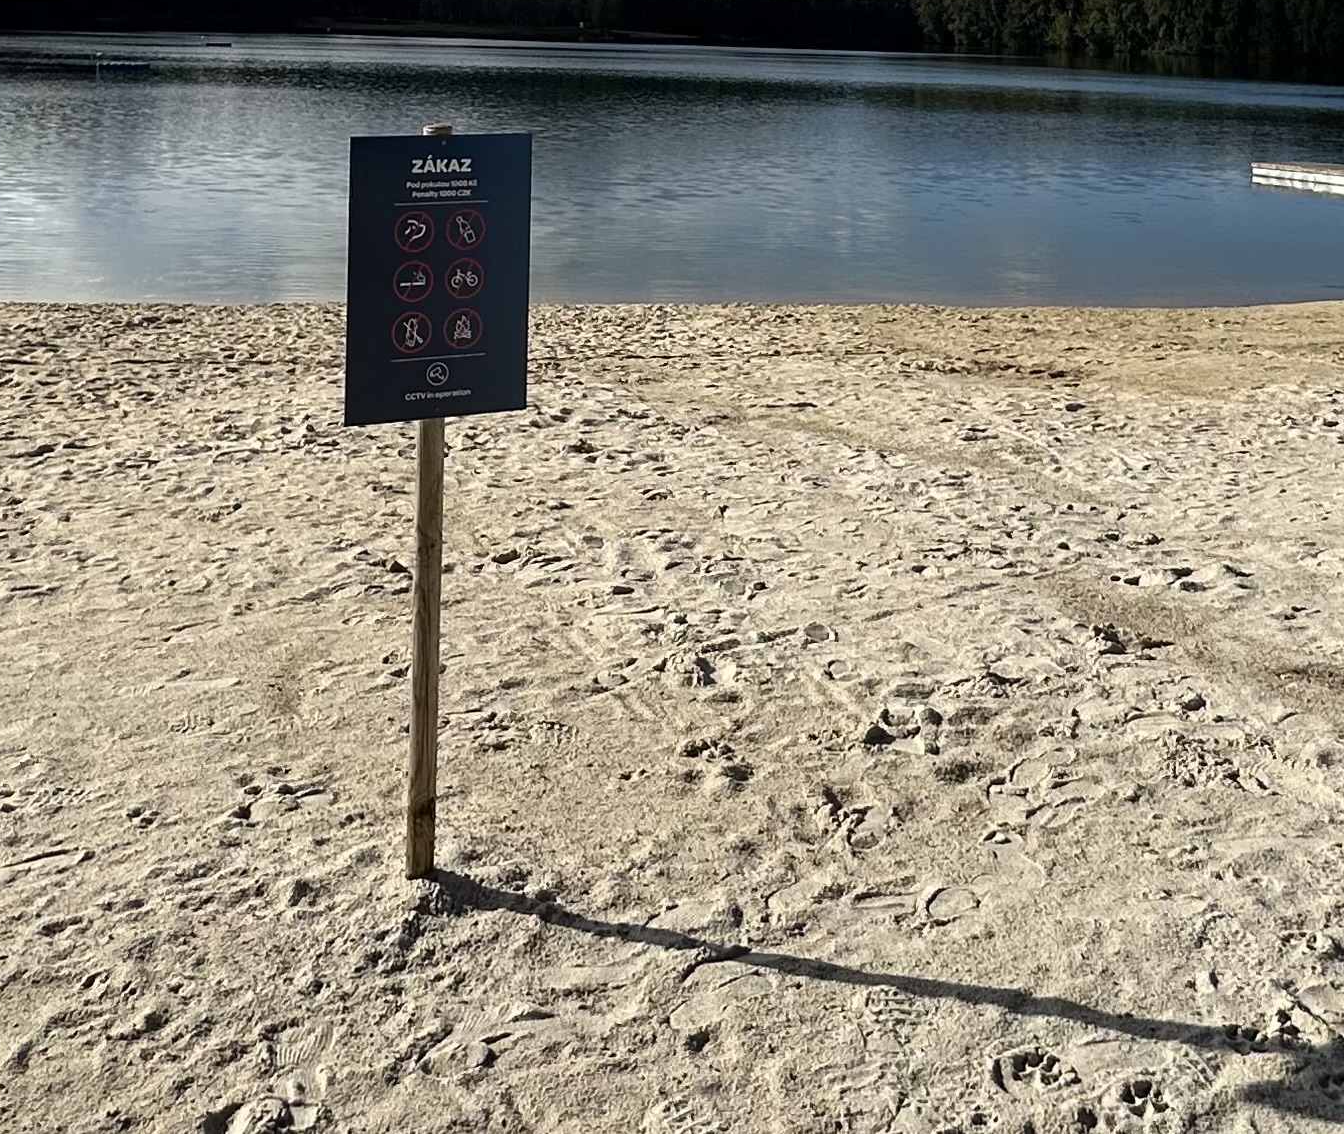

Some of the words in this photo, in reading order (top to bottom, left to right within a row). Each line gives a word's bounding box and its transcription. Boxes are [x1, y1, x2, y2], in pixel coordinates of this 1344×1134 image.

[411, 155, 472, 174] ZÁKAZ
[406, 181, 421, 189] Pod
[421, 181, 450, 190] pokutou
[457, 189, 472, 197] CZK
[405, 392, 427, 401] CCTV
[426, 391, 435, 399] in
[435, 389, 472, 399] operation
